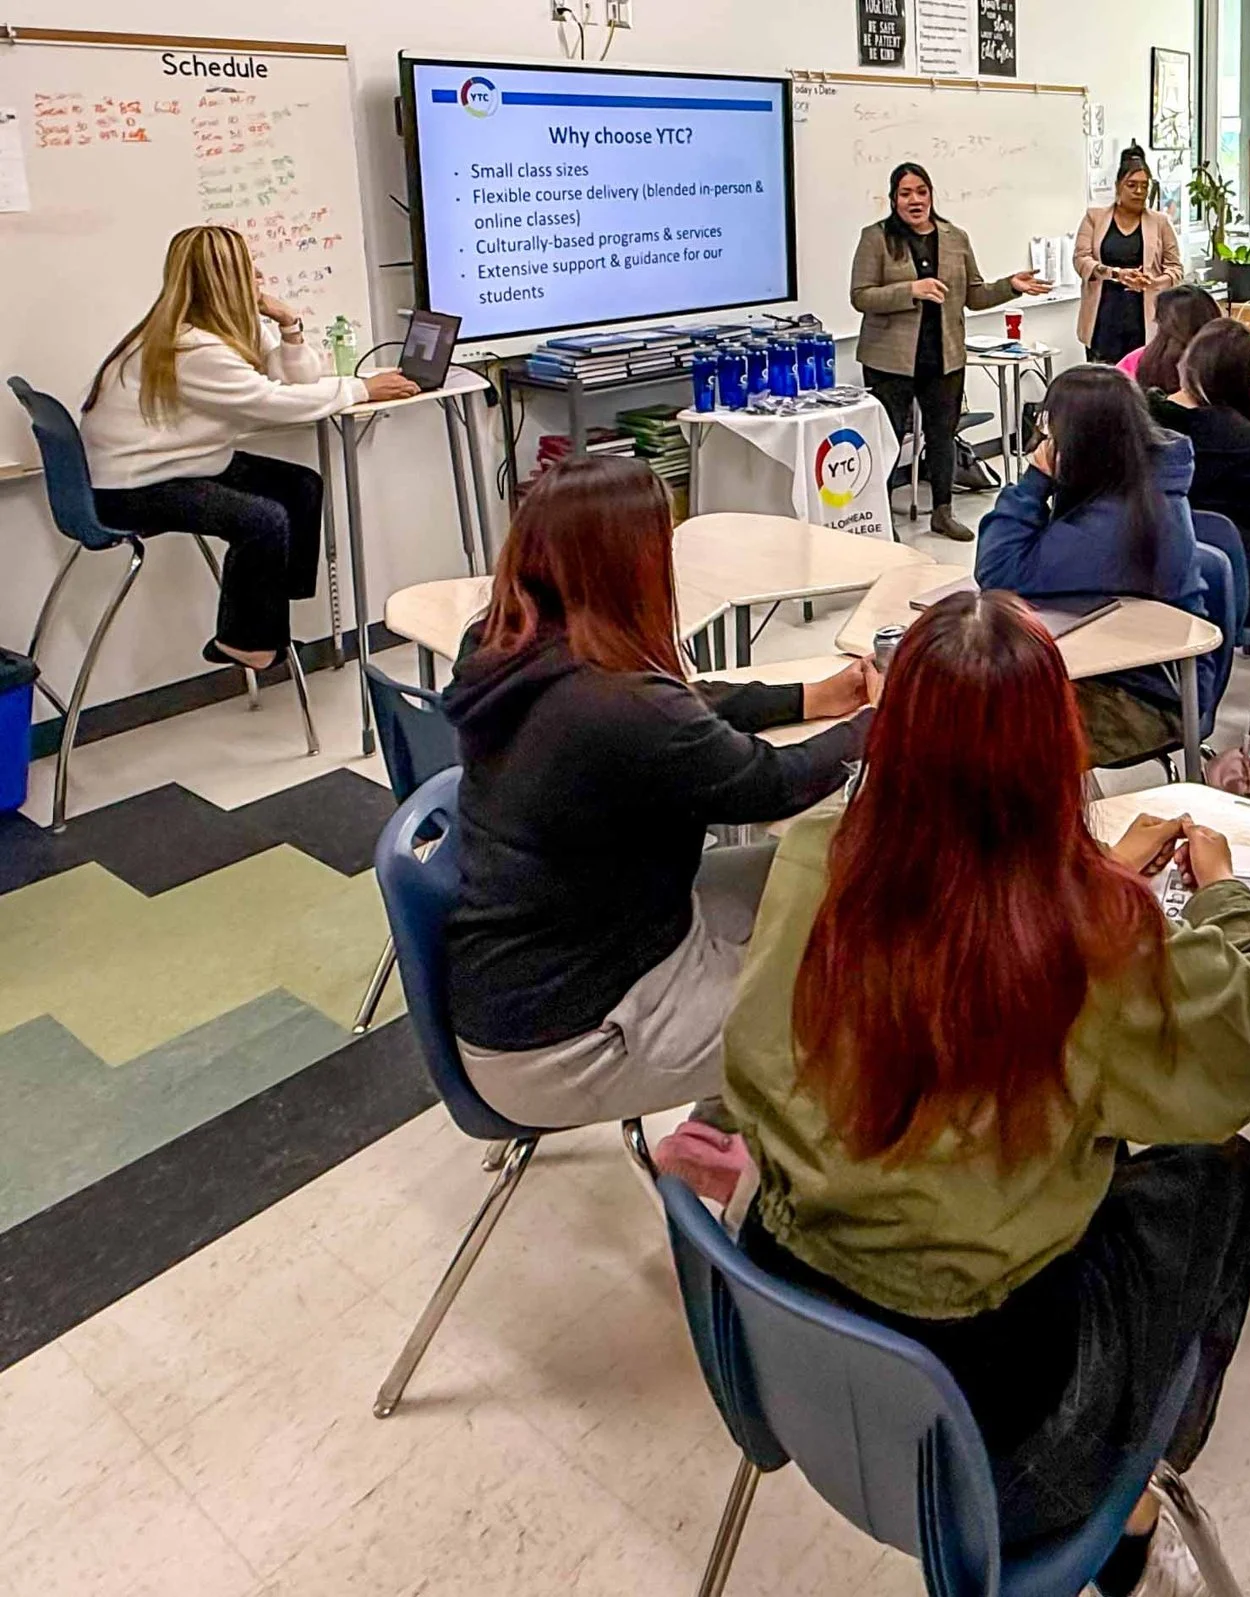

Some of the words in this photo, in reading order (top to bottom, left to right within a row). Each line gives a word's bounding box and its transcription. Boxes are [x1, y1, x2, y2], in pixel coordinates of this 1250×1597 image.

[880, 21, 896, 34] SAFE
[864, 34, 872, 46] BE
[874, 34, 901, 48] PATIENT
[869, 48, 878, 60] BE
[880, 48, 894, 60] KIND
[162, 53, 268, 78] Schedule
[470, 92, 489, 102] YTC
[549, 126, 590, 148] Why
[594, 126, 652, 145] choose
[656, 128, 693, 145] YTC?
[471, 162, 513, 179] Small
[517, 162, 552, 178] class
[556, 162, 589, 177] sizes
[472, 188, 531, 204] Flexible
[535, 190, 582, 202] course
[586, 184, 639, 203] delivery
[642, 182, 696, 200] (blended
[700, 180, 752, 198] in-person
[756, 180, 764, 194] &
[474, 213, 522, 230] online
[526, 210, 582, 228] classes)
[476, 233, 594, 258] Culturally-based
[598, 230, 660, 252] programs
[663, 228, 673, 241] &
[676, 226, 722, 241] services
[478, 260, 548, 280] Extensive
[552, 257, 606, 280] support
[610, 254, 622, 268] &
[624, 248, 680, 271] guidance
[682, 247, 700, 262] for
[704, 246, 723, 260] our
[480, 286, 545, 304] students
[828, 458, 856, 478] YTC
